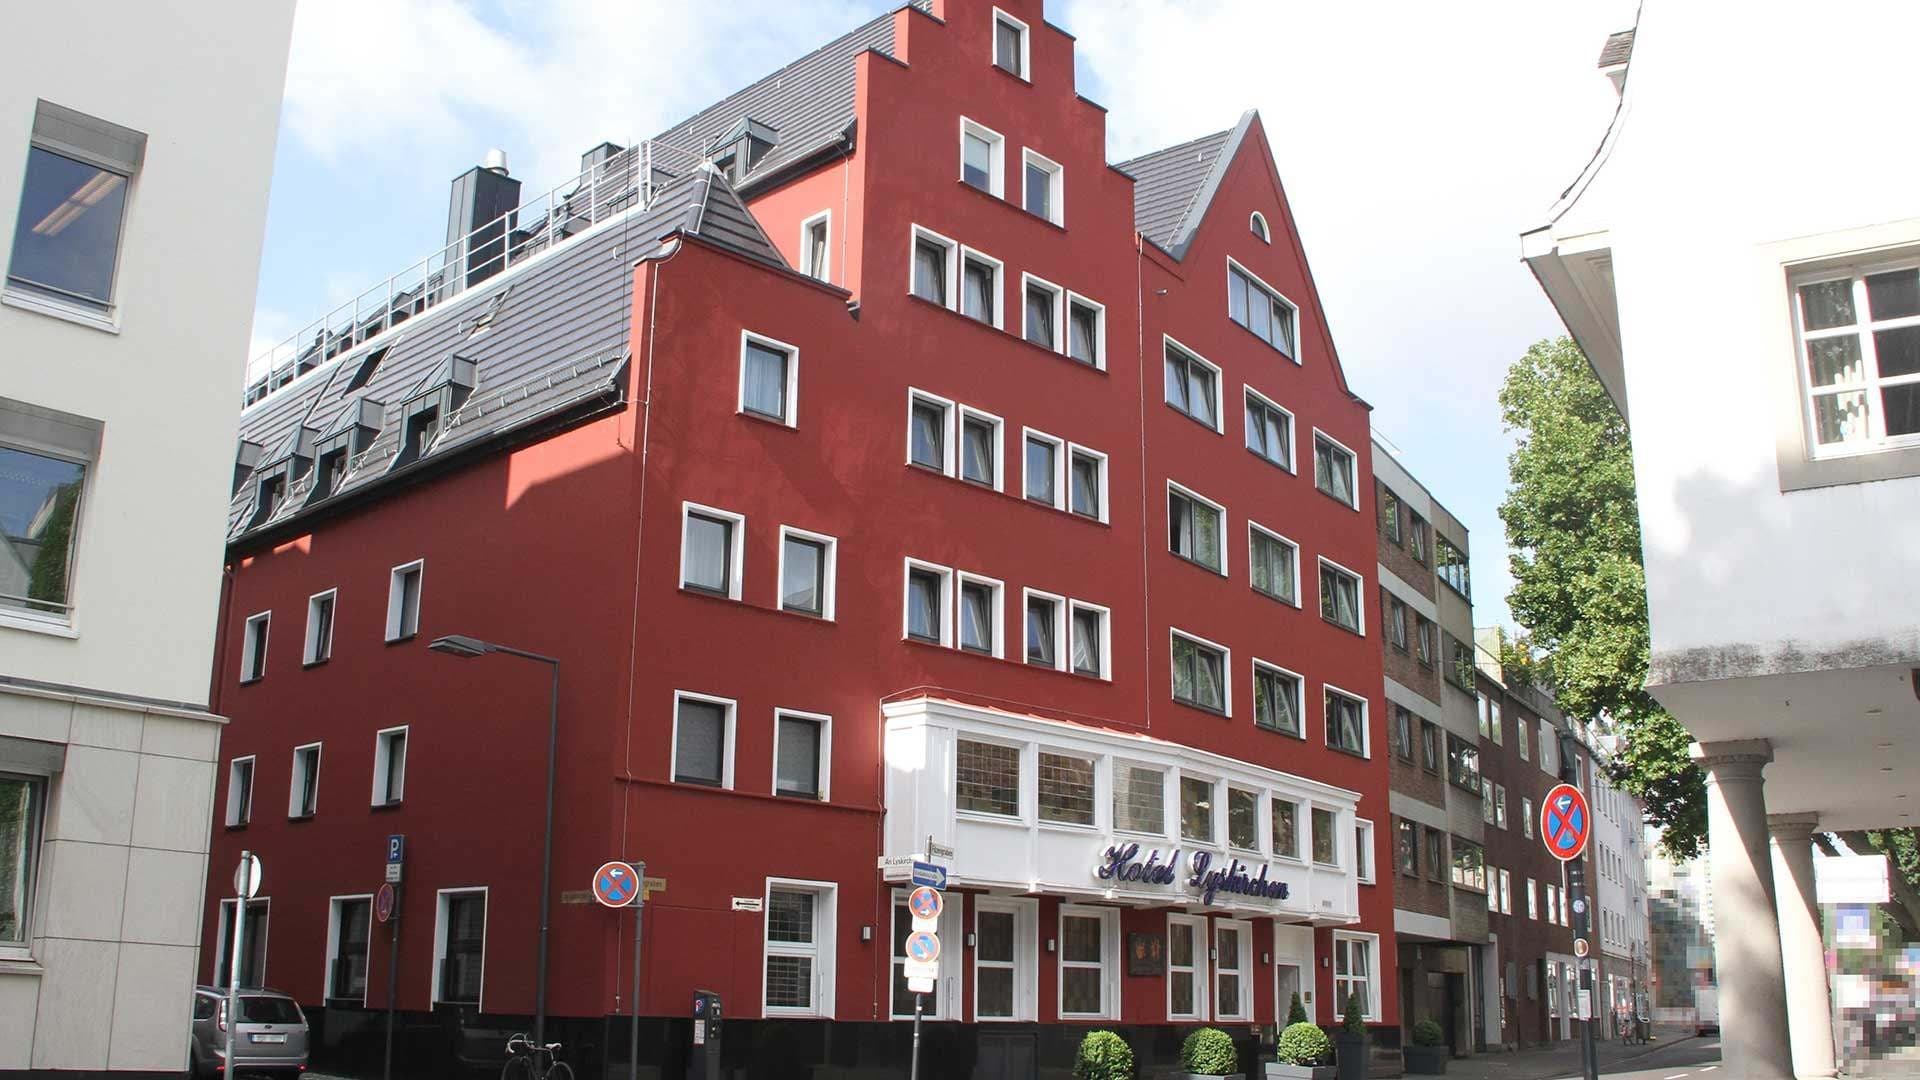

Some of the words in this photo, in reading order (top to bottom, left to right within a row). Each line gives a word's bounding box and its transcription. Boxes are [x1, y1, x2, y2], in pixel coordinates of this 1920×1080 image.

[390, 838, 399, 859] P
[1094, 842, 1180, 885] Hotel
[1185, 850, 1289, 905] Lyskirchen
